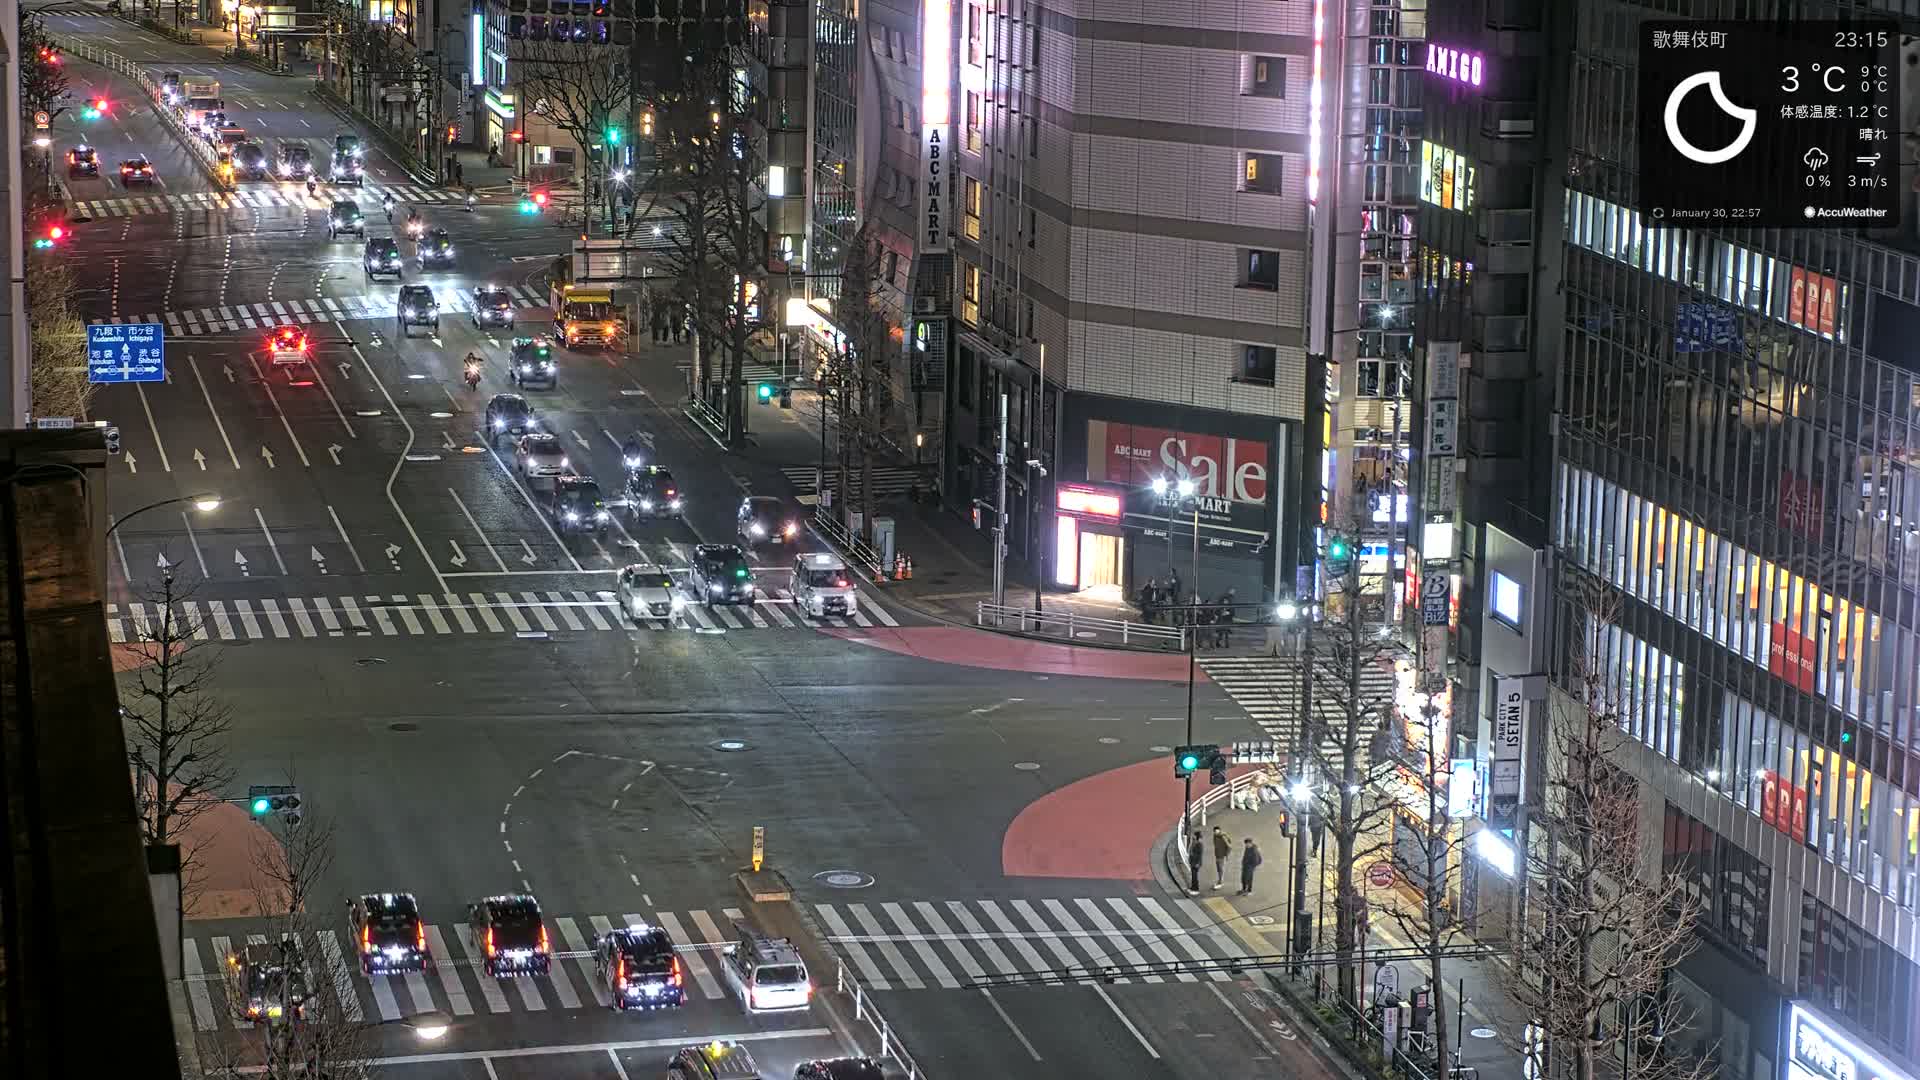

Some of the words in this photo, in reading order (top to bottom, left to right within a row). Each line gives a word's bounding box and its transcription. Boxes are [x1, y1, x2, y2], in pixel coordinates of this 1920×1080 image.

[1426, 44, 1482, 86] AMIGO
[1793, 279, 1833, 318] CPA
[95, 327, 122, 336] 九段下
[1159, 437, 1267, 504] Sale
[1771, 641, 1814, 673] professional
[1499, 702, 1507, 721] CITY
[1508, 692, 1521, 702] 5
[1498, 721, 1507, 741] PARK
[1506, 706, 1520, 747] ISETAN
[1765, 780, 1804, 829] CPA
